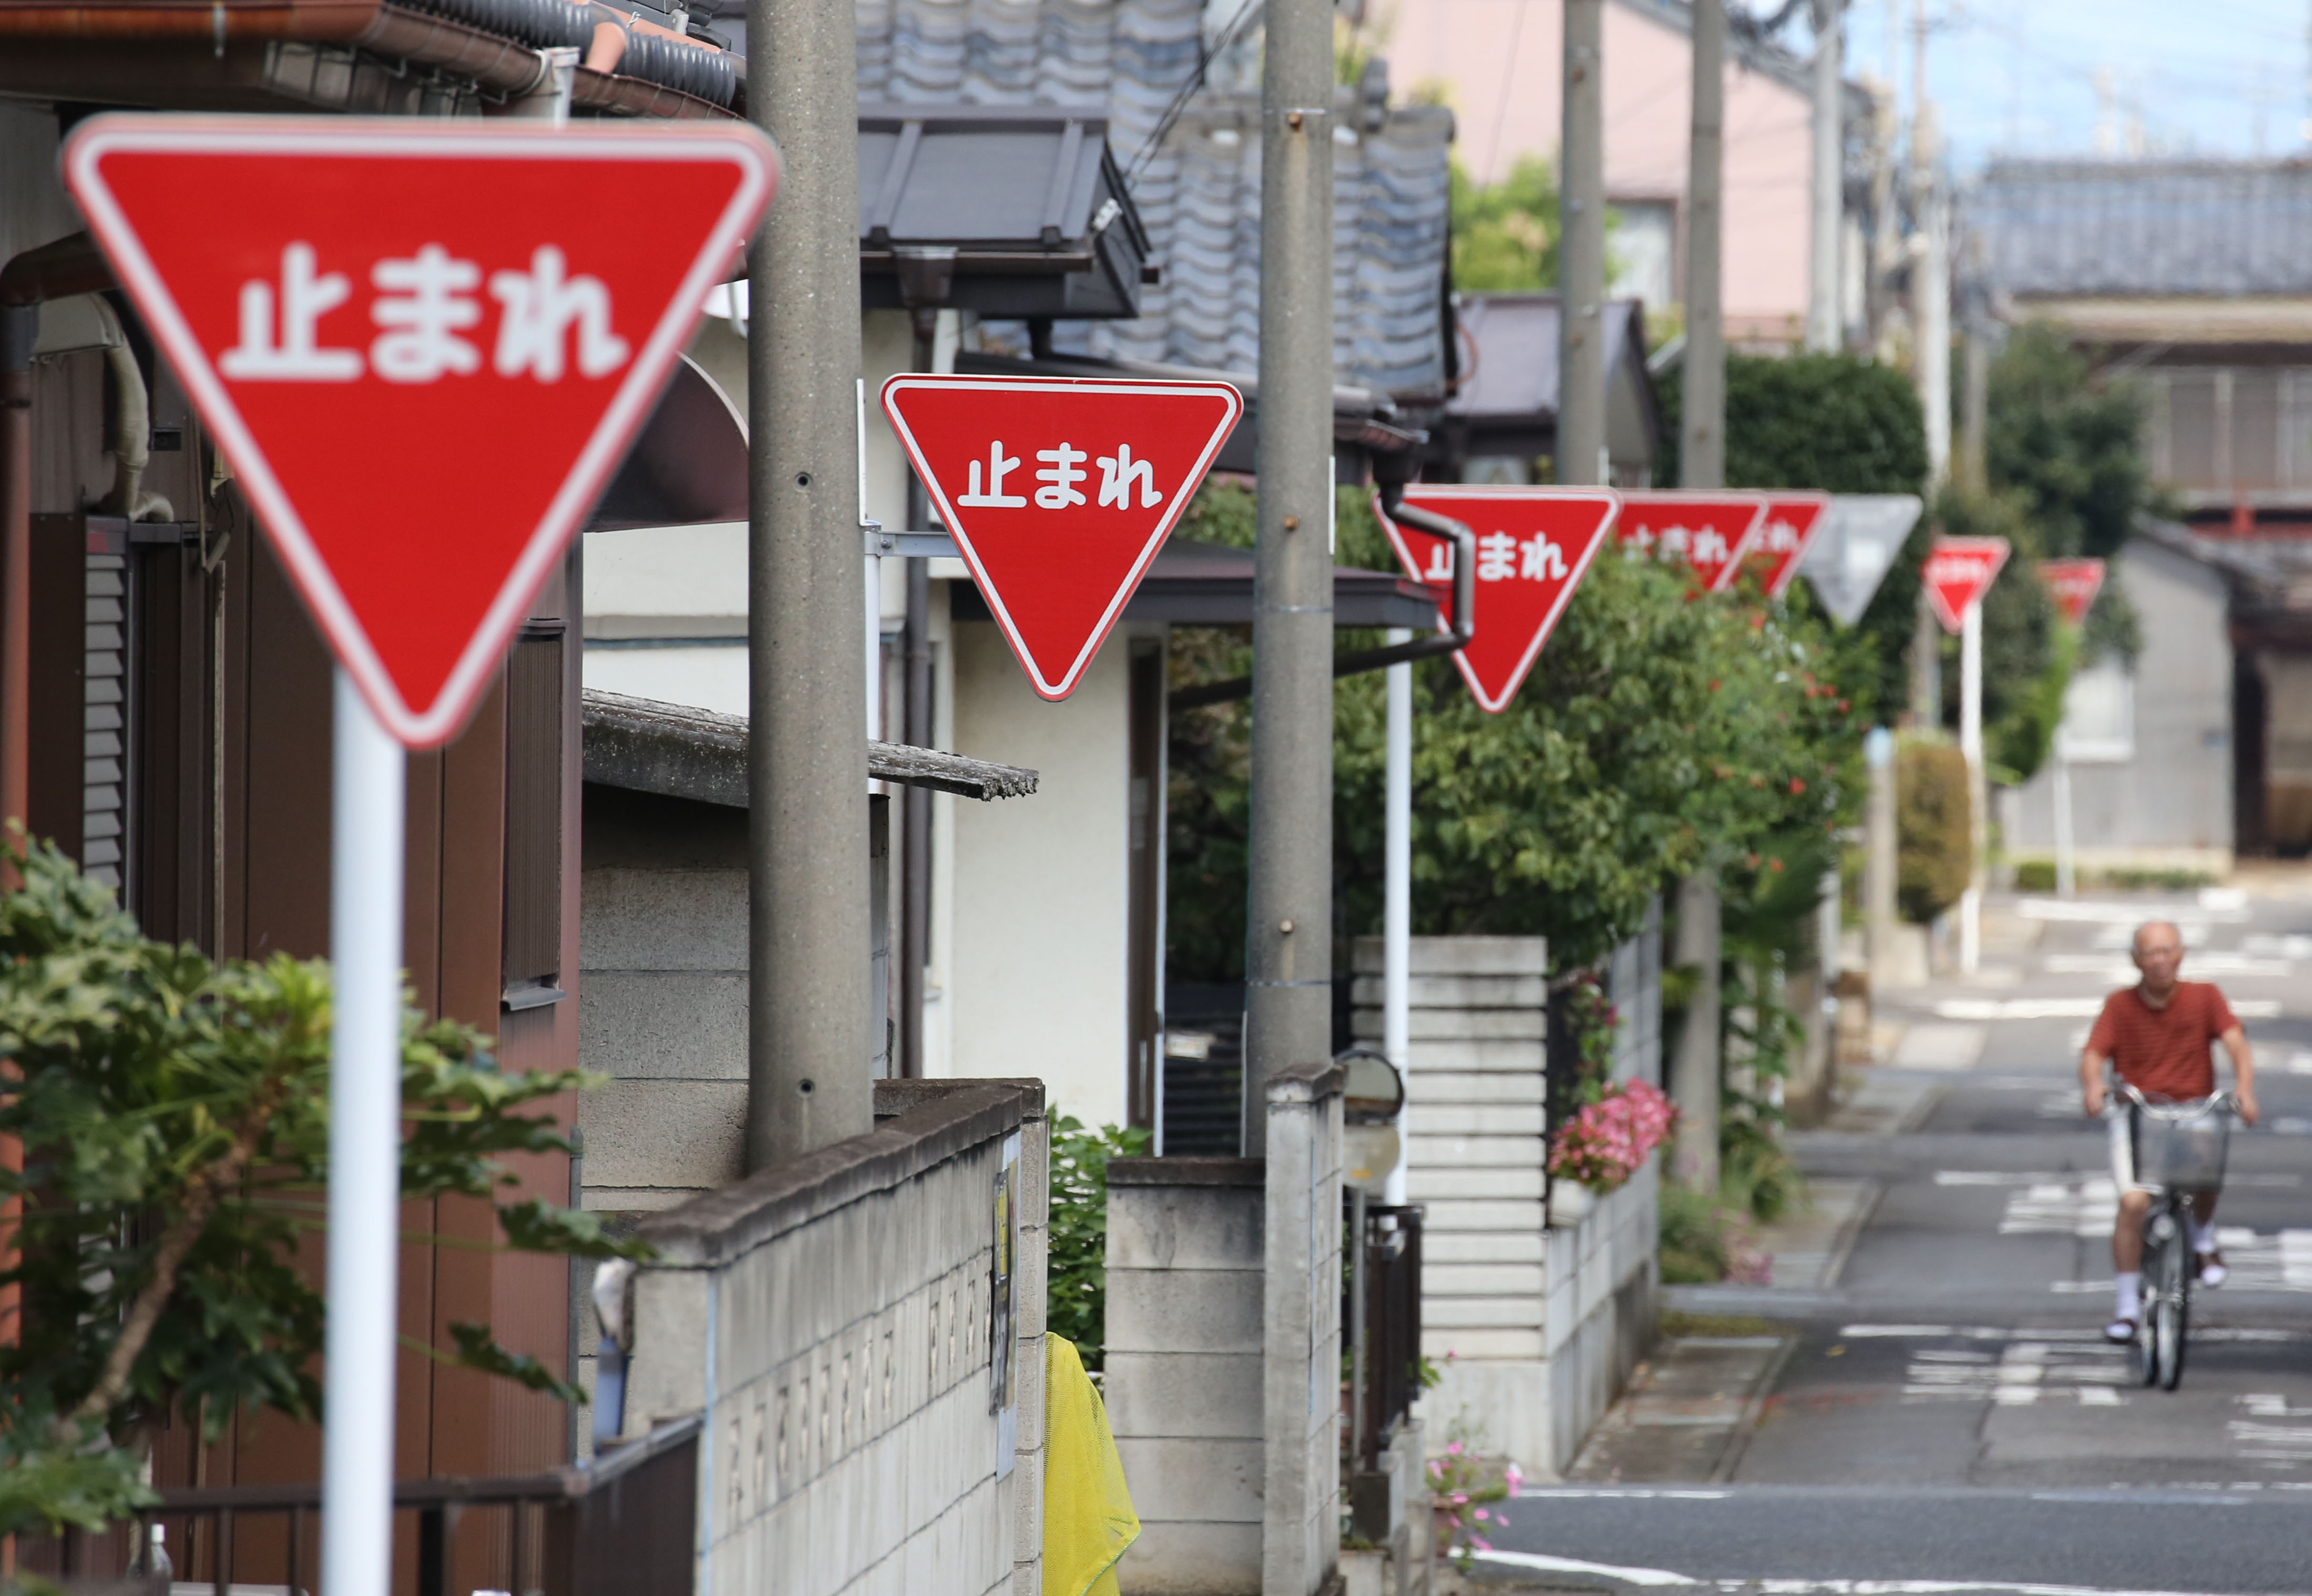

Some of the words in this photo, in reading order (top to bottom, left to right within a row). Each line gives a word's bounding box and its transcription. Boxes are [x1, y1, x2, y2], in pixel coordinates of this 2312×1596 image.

[220, 242, 628, 382] 止まれ
[957, 440, 1163, 510] 止まれ
